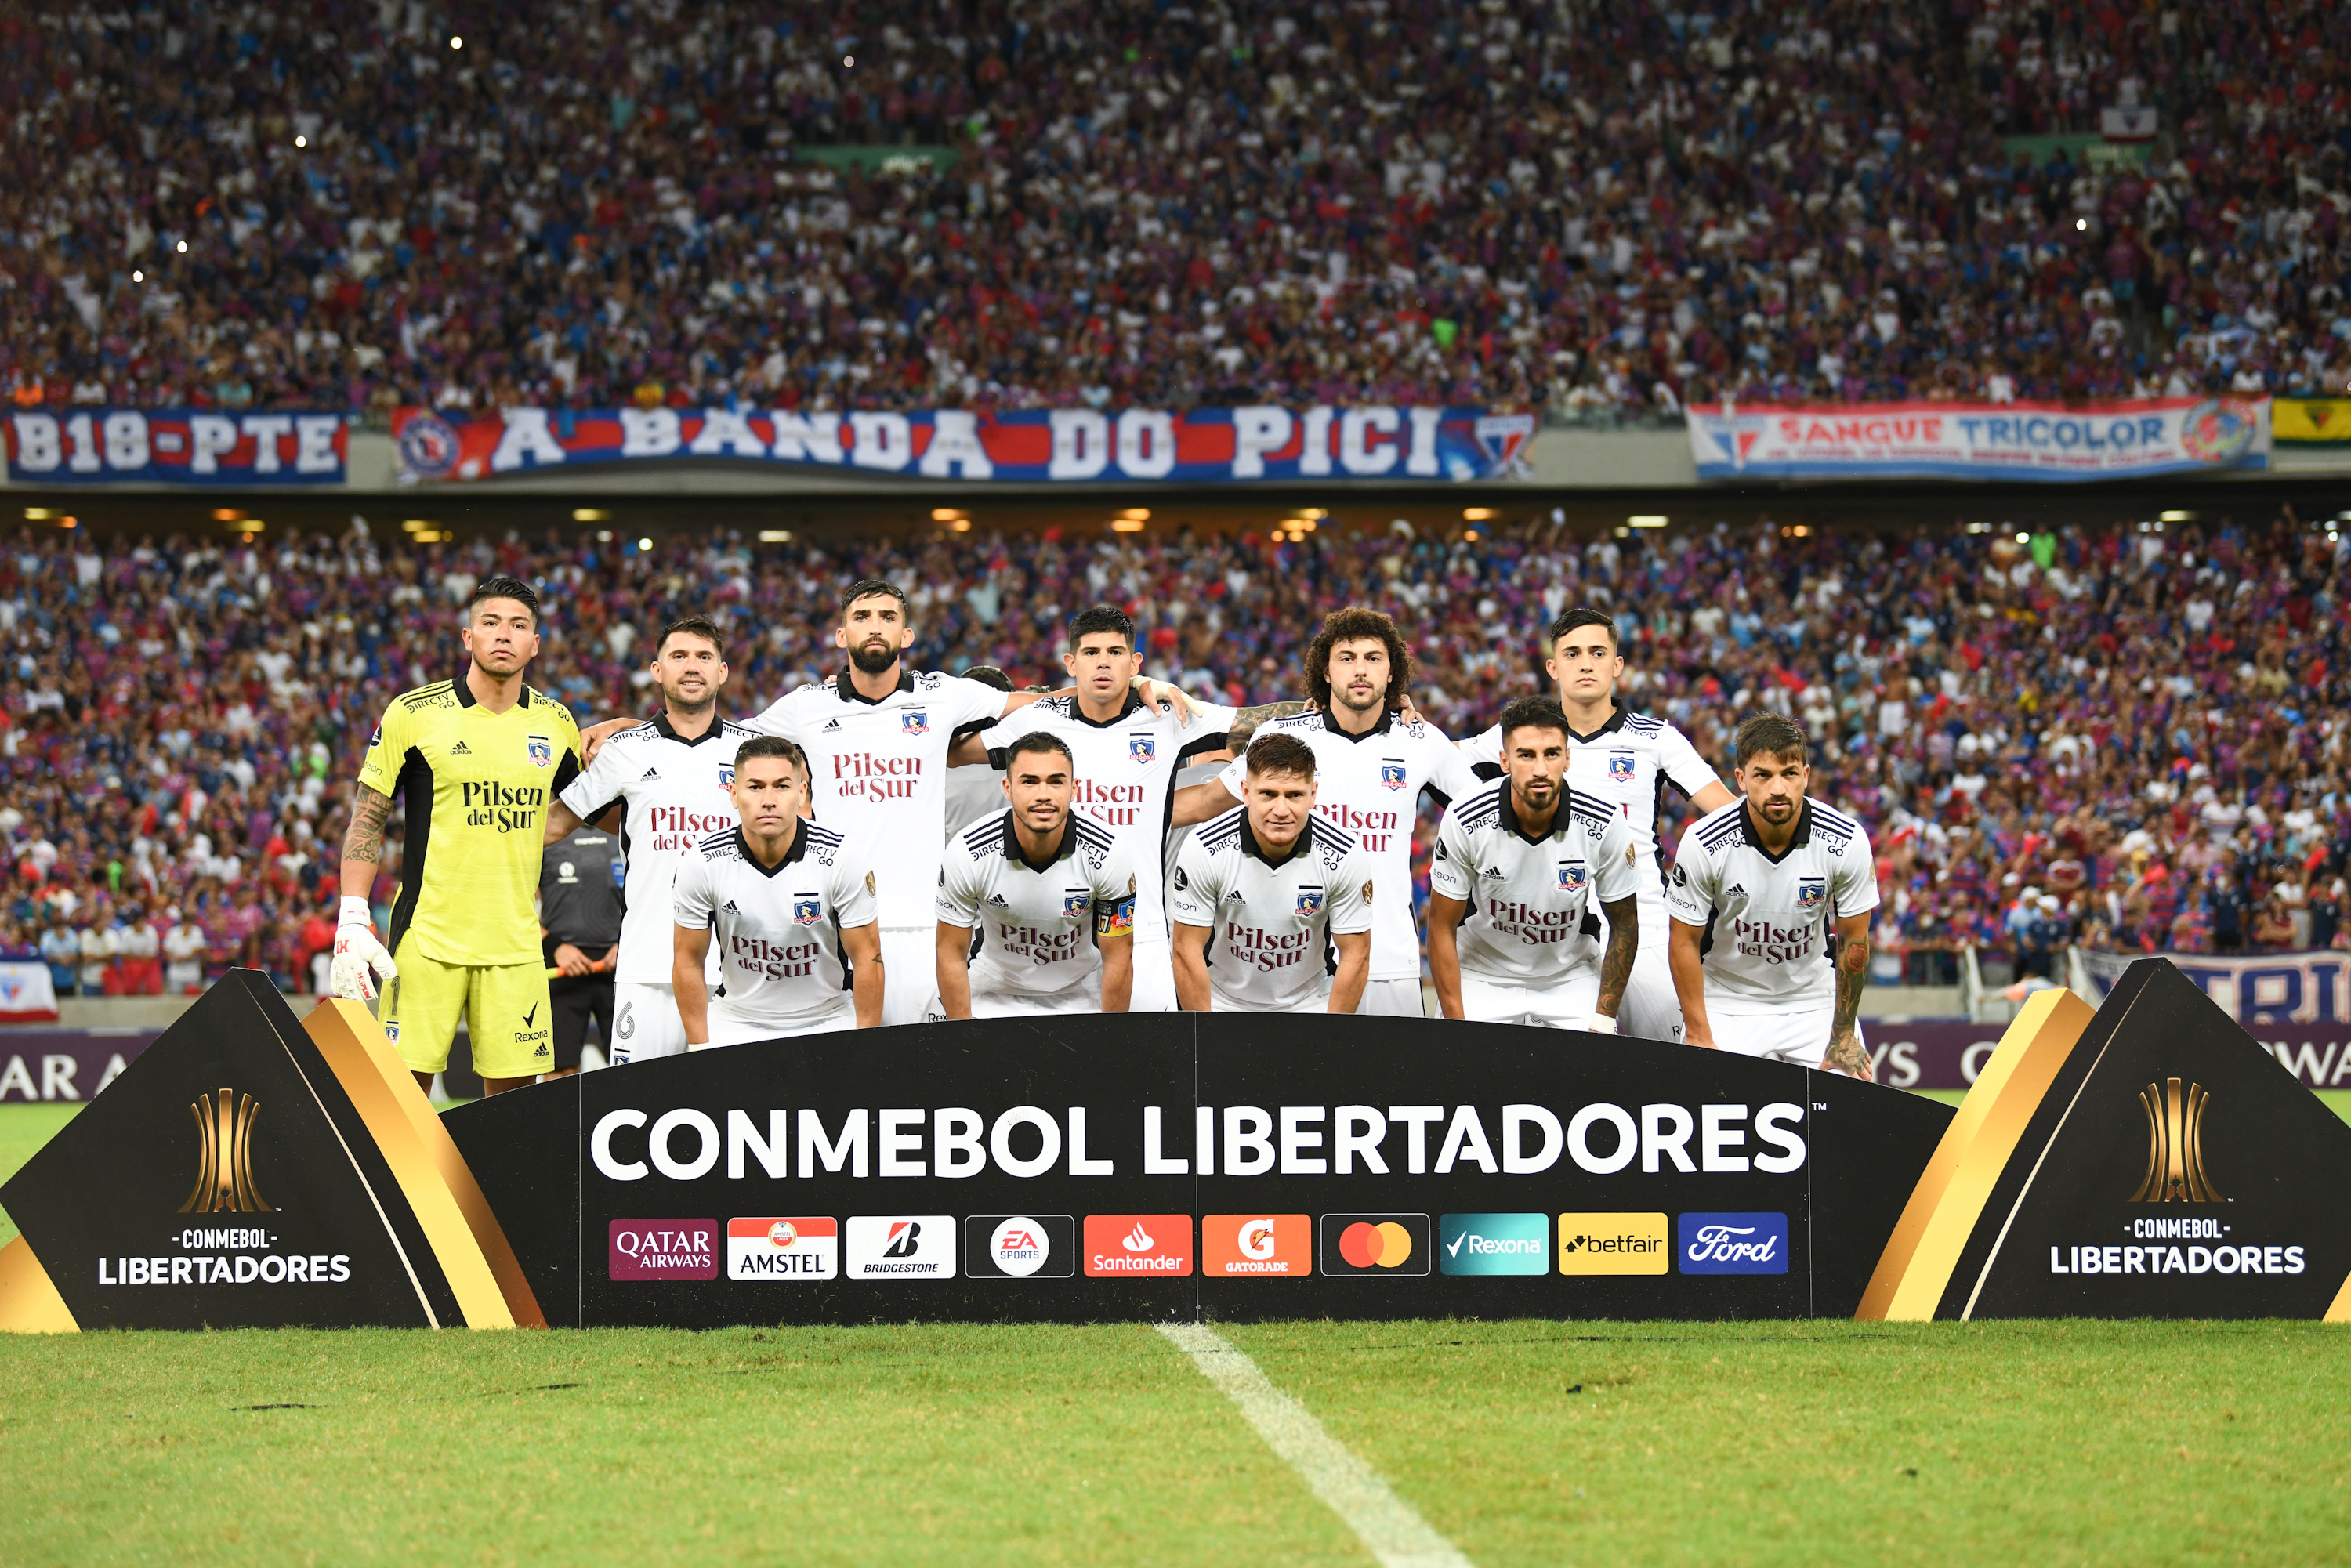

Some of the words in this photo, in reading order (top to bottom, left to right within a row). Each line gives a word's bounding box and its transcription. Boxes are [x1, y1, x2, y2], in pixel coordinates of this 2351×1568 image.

[13, 413, 339, 473] B18-PTE
[491, 408, 565, 469] A
[621, 406, 994, 479] BANDA
[1049, 408, 1176, 479] DO
[1233, 406, 1444, 479] PICI
[1780, 418, 1943, 444] SANGUE
[1957, 417, 2165, 449] TRICOLOR
[407, 693, 449, 714] DIRECTV
[439, 700, 455, 709] GO
[557, 710, 571, 722] GO
[611, 726, 657, 744] DIRECTV
[643, 733, 659, 742] GO
[1408, 730, 1425, 740] GO
[833, 752, 922, 780] Pilsen
[462, 780, 543, 807] Pilsen
[839, 779, 866, 797] del
[869, 777, 918, 803] Sur
[1074, 779, 1145, 804] ilsen
[467, 808, 494, 827] del
[497, 808, 538, 834] Sur
[650, 806, 732, 833] Pilsen
[1464, 809, 1500, 835] DIRECT
[1570, 811, 1607, 832] IRECTV
[653, 834, 679, 852] del
[1206, 832, 1241, 857] DIRECT
[1587, 828, 1603, 841] GO
[1811, 827, 1849, 849] IRECTV
[703, 846, 738, 863] DIRECT
[806, 844, 838, 858] RECTV
[970, 838, 1005, 861] DIRECT
[1312, 837, 1344, 863] IRECTV
[1828, 844, 1844, 857] GO
[818, 856, 835, 867] GO
[1088, 856, 1103, 871] GO
[1323, 856, 1338, 871] GO
[1482, 872, 1505, 881] adidas
[721, 907, 741, 916] adidas
[794, 914, 822, 924] COLO-COLO
[1489, 898, 1577, 926] Pilsen
[1000, 923, 1083, 947] Pilsen
[1227, 921, 1311, 951] Pilsen
[1492, 920, 1520, 936] del
[1522, 924, 1573, 946] Sur
[731, 935, 821, 962] Pilsen
[1004, 942, 1031, 957] del
[1033, 941, 1081, 966] Sur
[1230, 943, 1255, 964] del
[1257, 945, 1309, 972] Sur
[1737, 940, 1763, 957] del
[1766, 937, 1814, 965] Sur
[738, 957, 764, 974] del
[765, 958, 817, 982] Sur
[615, 1000, 636, 1040] 6
[928, 1012, 948, 1023] Rex
[514, 1030, 549, 1044] Rexona
[590, 1105, 1114, 1181] CONMEBOL
[1143, 1102, 1807, 1177] LIBERTADORES
[615, 1230, 710, 1258] QATAR
[1001, 1229, 1039, 1250] EA
[1469, 1234, 1541, 1254] Rexona
[1588, 1234, 1663, 1253] betfair
[1687, 1224, 1778, 1262] Ford
[639, 1254, 712, 1269] AIRWAYS
[740, 1254, 826, 1273] AMSTEL
[999, 1250, 1040, 1260] SPORTS
[1093, 1254, 1183, 1271] Santander
[2050, 1245, 2306, 1274] LIBERTADORES
[98, 1255, 351, 1285] LIBERTADORES
[863, 1262, 939, 1273] BRIDGESTONE
[1225, 1262, 1288, 1273] GATORADE
